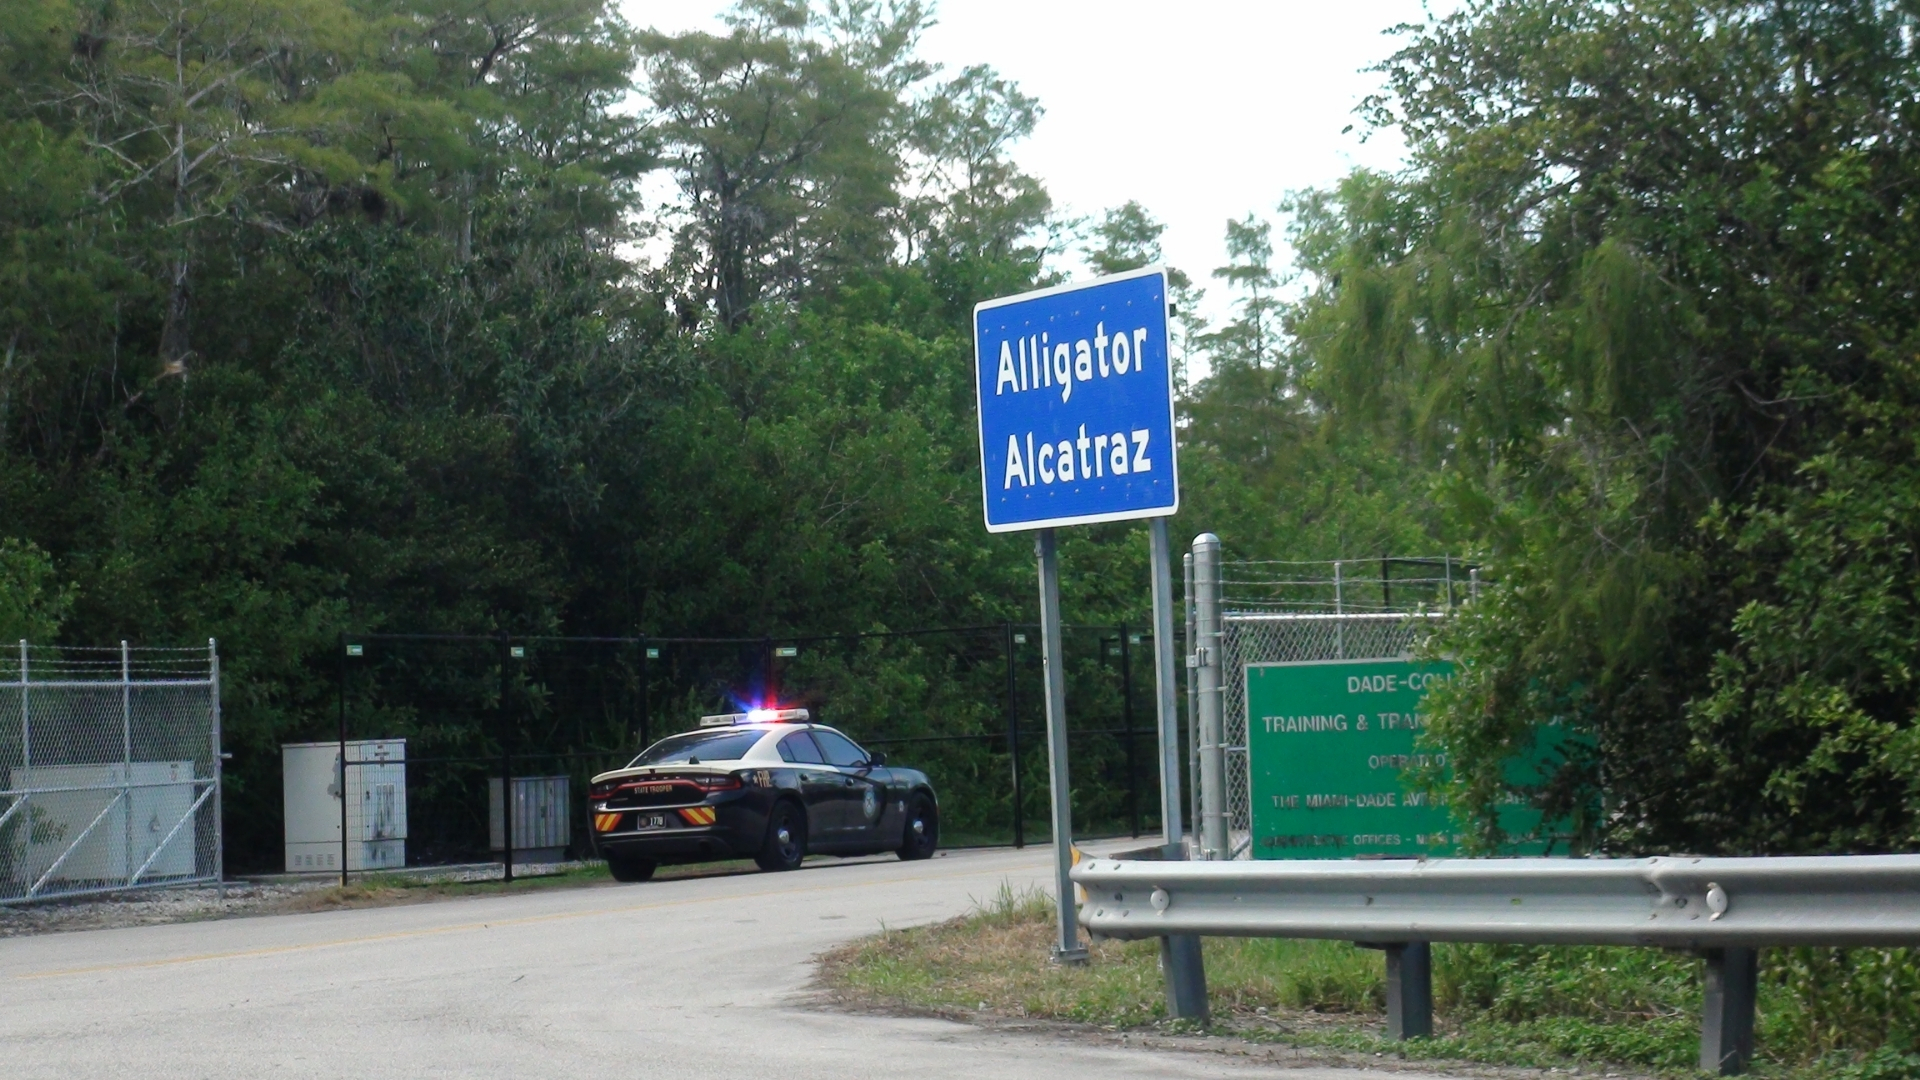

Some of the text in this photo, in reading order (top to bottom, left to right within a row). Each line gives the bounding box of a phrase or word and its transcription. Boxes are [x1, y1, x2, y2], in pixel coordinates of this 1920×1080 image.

[995, 320, 1148, 404] Alligator
[1003, 422, 1152, 490] Alcatraz
[1262, 714, 1348, 733] TRAINING
[1356, 714, 1370, 731] &
[634, 785, 673, 794] STATE TROOPER
[1271, 795, 1299, 808] THE
[1306, 793, 1396, 808] MIAMI-DADE
[1353, 834, 1401, 846] OFFICES
